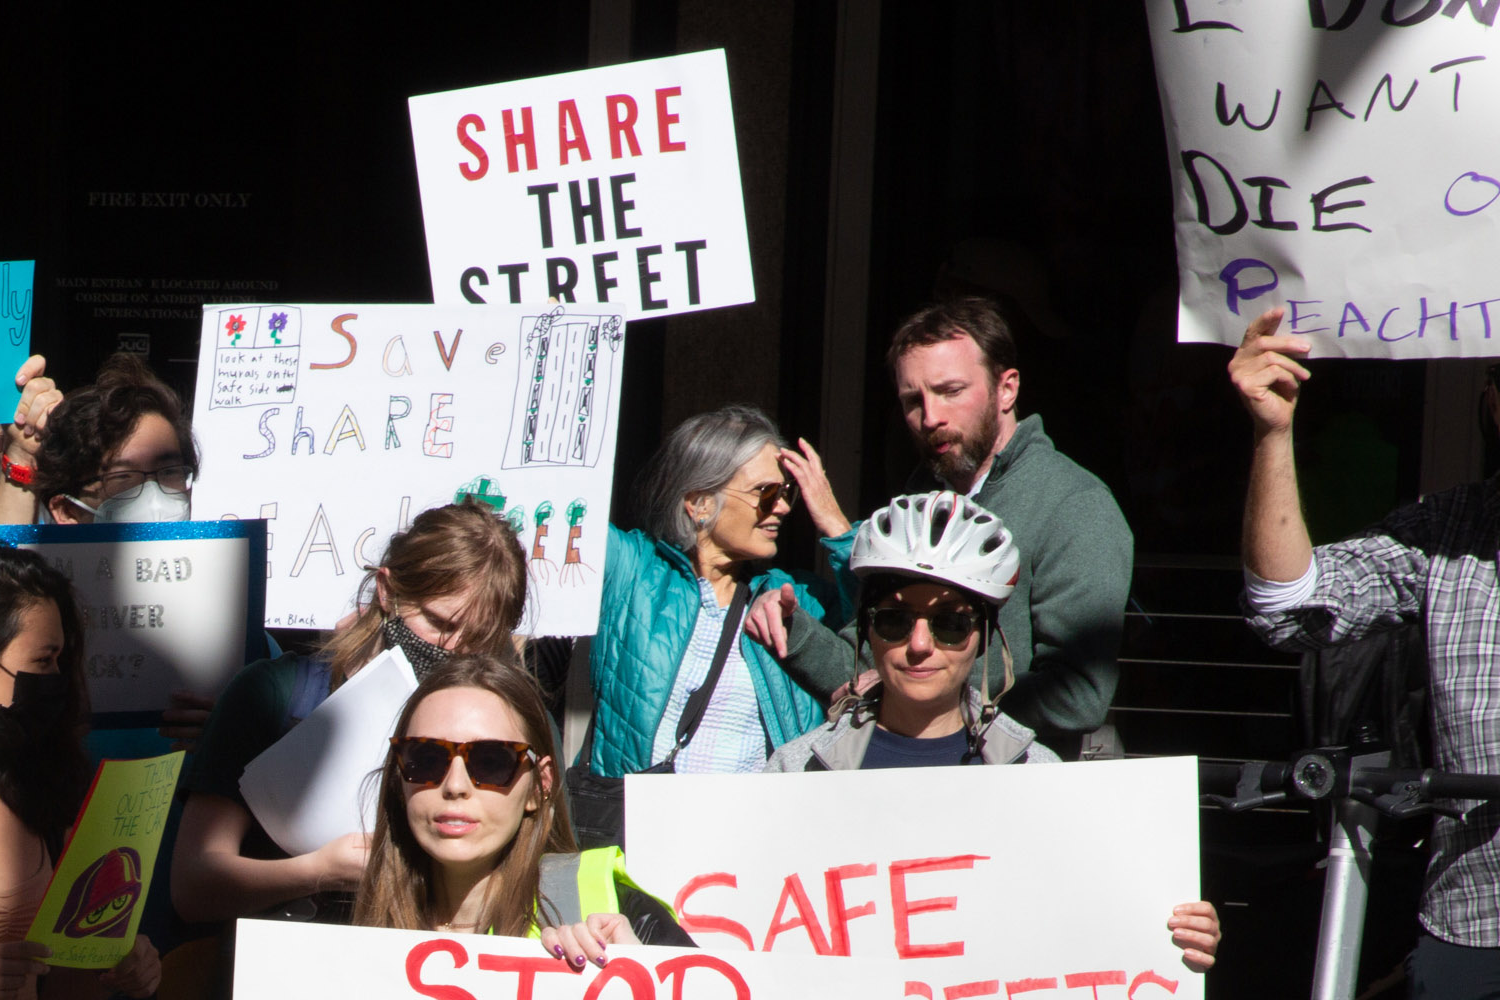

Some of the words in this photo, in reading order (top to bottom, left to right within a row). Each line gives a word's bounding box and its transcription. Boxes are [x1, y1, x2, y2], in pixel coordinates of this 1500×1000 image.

[1215, 56, 1486, 131] WANT
[455, 86, 687, 181] SHARE
[88, 191, 137, 208] FIRE
[141, 192, 192, 209] EXIT
[194, 191, 252, 209] ONLY
[1181, 150, 1375, 236] DIE
[526, 172, 643, 249] THE
[56, 278, 89, 289] MAIN
[160, 280, 220, 292] LOCATED
[223, 281, 278, 293] AROUND
[76, 292, 127, 304] CORNER
[131, 293, 149, 305] ON
[153, 294, 204, 306] ANDREW
[93, 308, 198, 320] INTERNATIONAL
[219, 352, 244, 363] look
[251, 353, 263, 362] at
[274, 353, 299, 366] these
[217, 367, 259, 380] murals
[248, 382, 270, 394] side
[214, 395, 242, 406] walk
[136, 557, 193, 584] BAD
[113, 815, 141, 837] THE
[674, 854, 990, 960] SAFE
